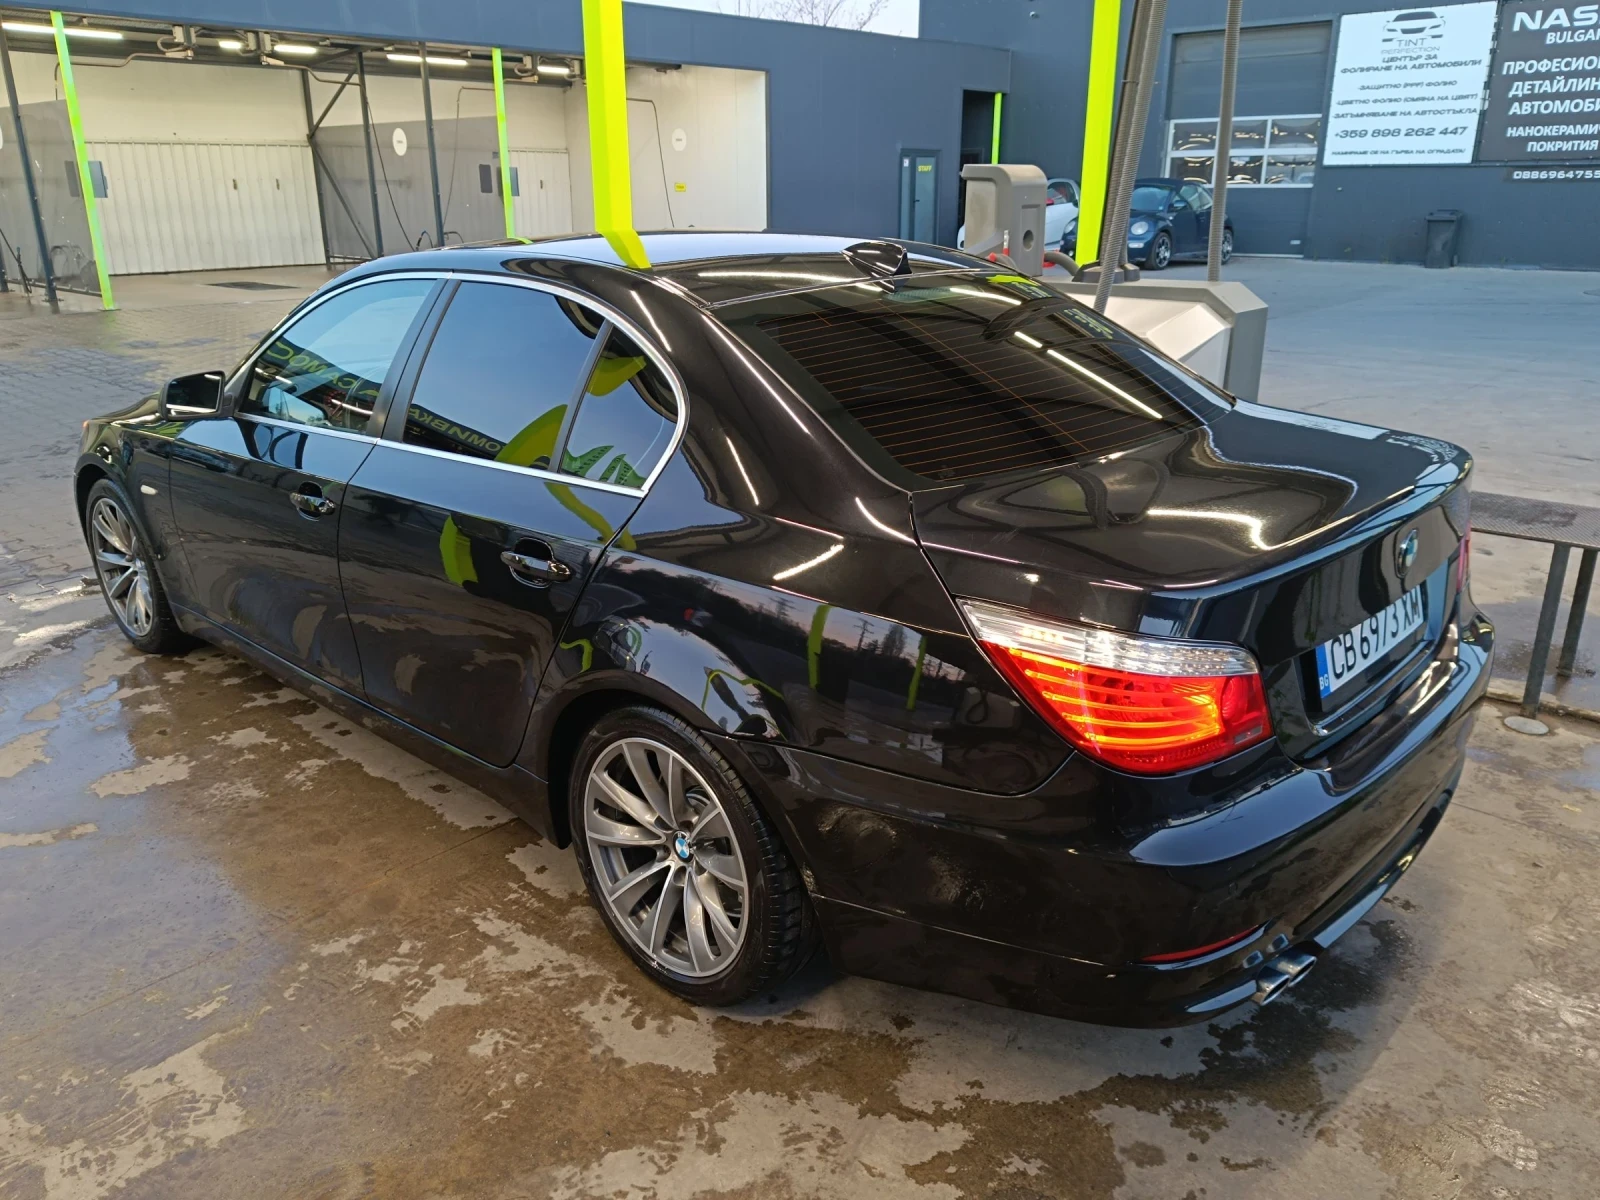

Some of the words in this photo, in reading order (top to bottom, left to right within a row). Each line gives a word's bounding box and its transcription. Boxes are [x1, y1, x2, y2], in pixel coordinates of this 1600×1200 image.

[1513, 5, 1600, 31] NAS
[1396, 38, 1427, 47] TINT
[1381, 46, 1440, 55] PERFECTION
[1382, 55, 1422, 64] ЦЕНТЪР
[1340, 65, 1392, 74] ФОЛИРАНЕ
[1410, 59, 1482, 70] АВТОМОБИЛИ
[1413, 107, 1477, 116] АВТОСТЪКЛА
[1334, 129, 1368, 139] +359
[1371, 128, 1401, 138] 898
[1404, 127, 1436, 137] 262
[1438, 126, 1468, 135] 447
[1506, 123, 1600, 137] НАНОКЕРАМИ
[1526, 140, 1599, 152] ПОКРИТИЯ
[1359, 603, 1400, 660] 6973
[1319, 673, 1329, 690] BG
